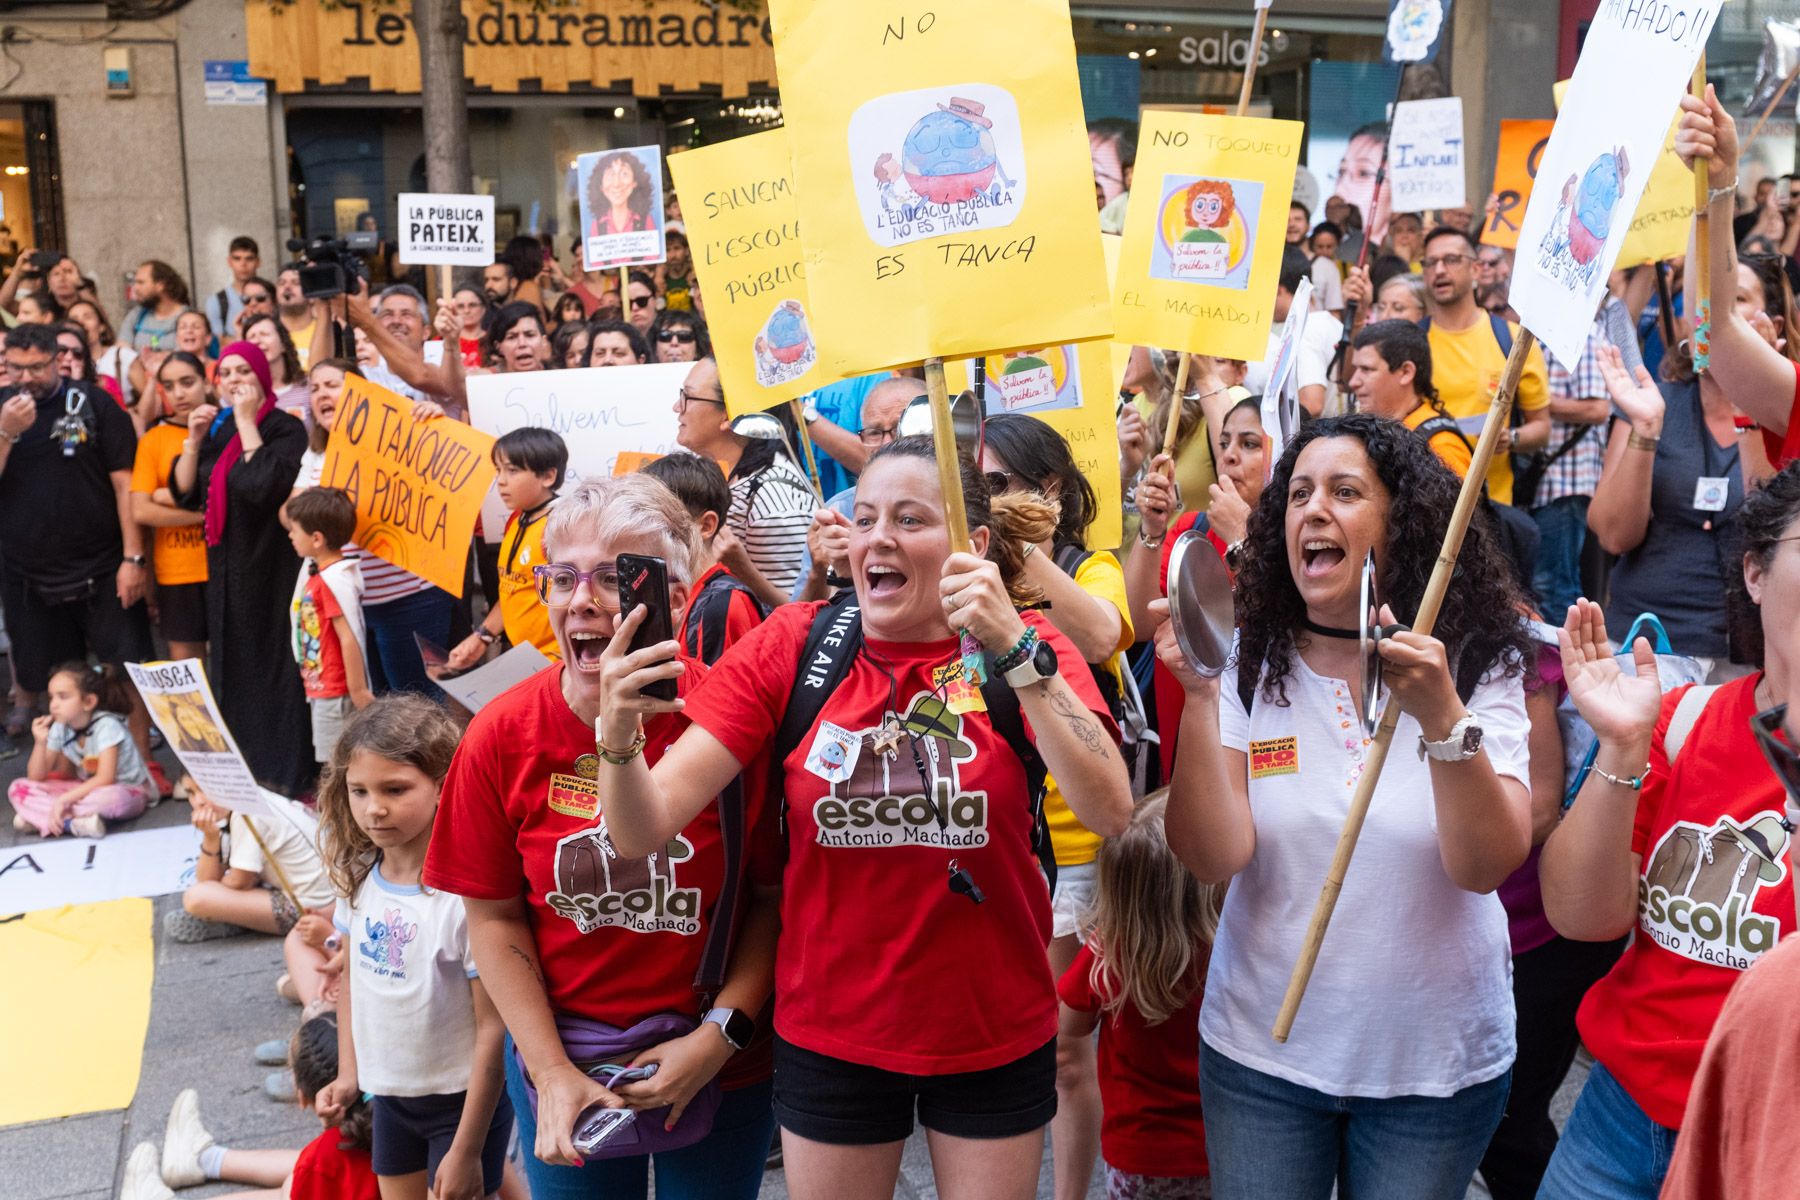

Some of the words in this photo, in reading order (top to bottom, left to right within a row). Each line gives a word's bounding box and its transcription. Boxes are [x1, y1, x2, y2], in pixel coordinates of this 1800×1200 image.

[342, 0, 774, 47] leduramadr
[882, 11, 936, 46] NO
[1152, 129, 1190, 148] NO
[1206, 133, 1292, 158] TOQUEU
[409, 207, 424, 220] LA
[428, 204, 484, 221] PÚBLICA
[703, 177, 793, 220] SALVEM
[877, 193, 951, 229] L'EDUCACIÓ
[410, 222, 484, 245] PATEIX.
[891, 224, 912, 240] NO
[917, 219, 935, 235] ES
[938, 210, 980, 232] TANCA
[876, 252, 905, 281] ES
[936, 234, 1037, 268] TANCA
[1212, 243, 1223, 255] la
[725, 261, 807, 305] PÚBLIC
[1122, 290, 1146, 308] EL
[1038, 367, 1047, 379] la
[334, 387, 370, 446] NO
[376, 402, 482, 494] TANQUEU
[1078, 458, 1099, 474] EM
[368, 467, 449, 551] PÚBLICA
[823, 605, 861, 648] NIKE
[804, 650, 833, 689] AIR
[1251, 737, 1295, 748] L'EDUCACIÓ
[1253, 750, 1295, 766] NO
[551, 787, 597, 805] NO
[553, 780, 598, 796] PÚBLICA
[555, 774, 598, 789] L'EDUCACI
[564, 800, 595, 812] TANCA
[816, 781, 984, 830] escola
[819, 829, 893, 846] Antonio
[902, 826, 986, 846] Machado
[548, 878, 698, 922] escola
[622, 911, 698, 933] Machado
[1688, 936, 1753, 970] Macha
